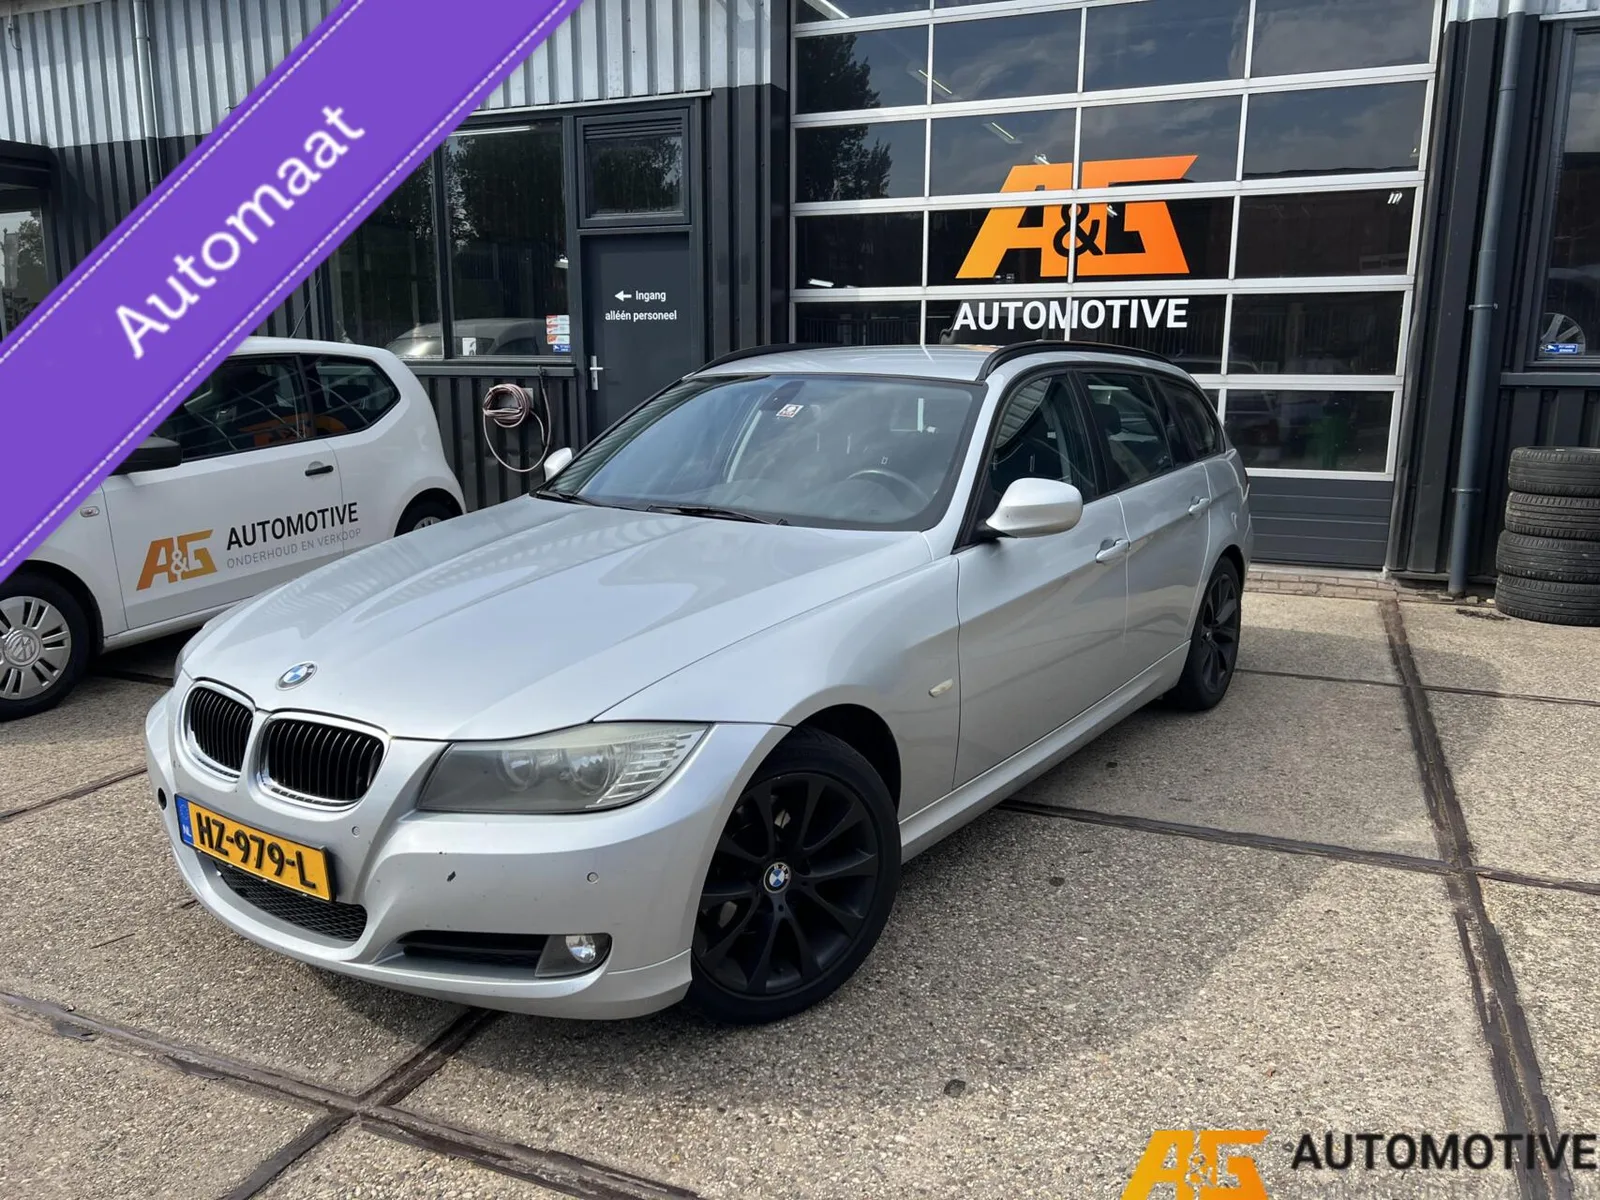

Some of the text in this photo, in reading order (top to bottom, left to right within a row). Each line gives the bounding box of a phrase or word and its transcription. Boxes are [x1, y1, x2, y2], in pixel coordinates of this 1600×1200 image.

[955, 154, 1199, 279] A&G
[604, 309, 677, 323] alléén personeel
[635, 290, 667, 303] Ingang
[953, 298, 1190, 331] AUTOMOTIVE
[226, 502, 359, 551] AUTOMOTIVE
[135, 529, 218, 592] A&G
[226, 527, 362, 569] ONDERHOUD EN VERKOOP
[181, 824, 192, 838] NL
[195, 812, 317, 889] HZ-979-L
